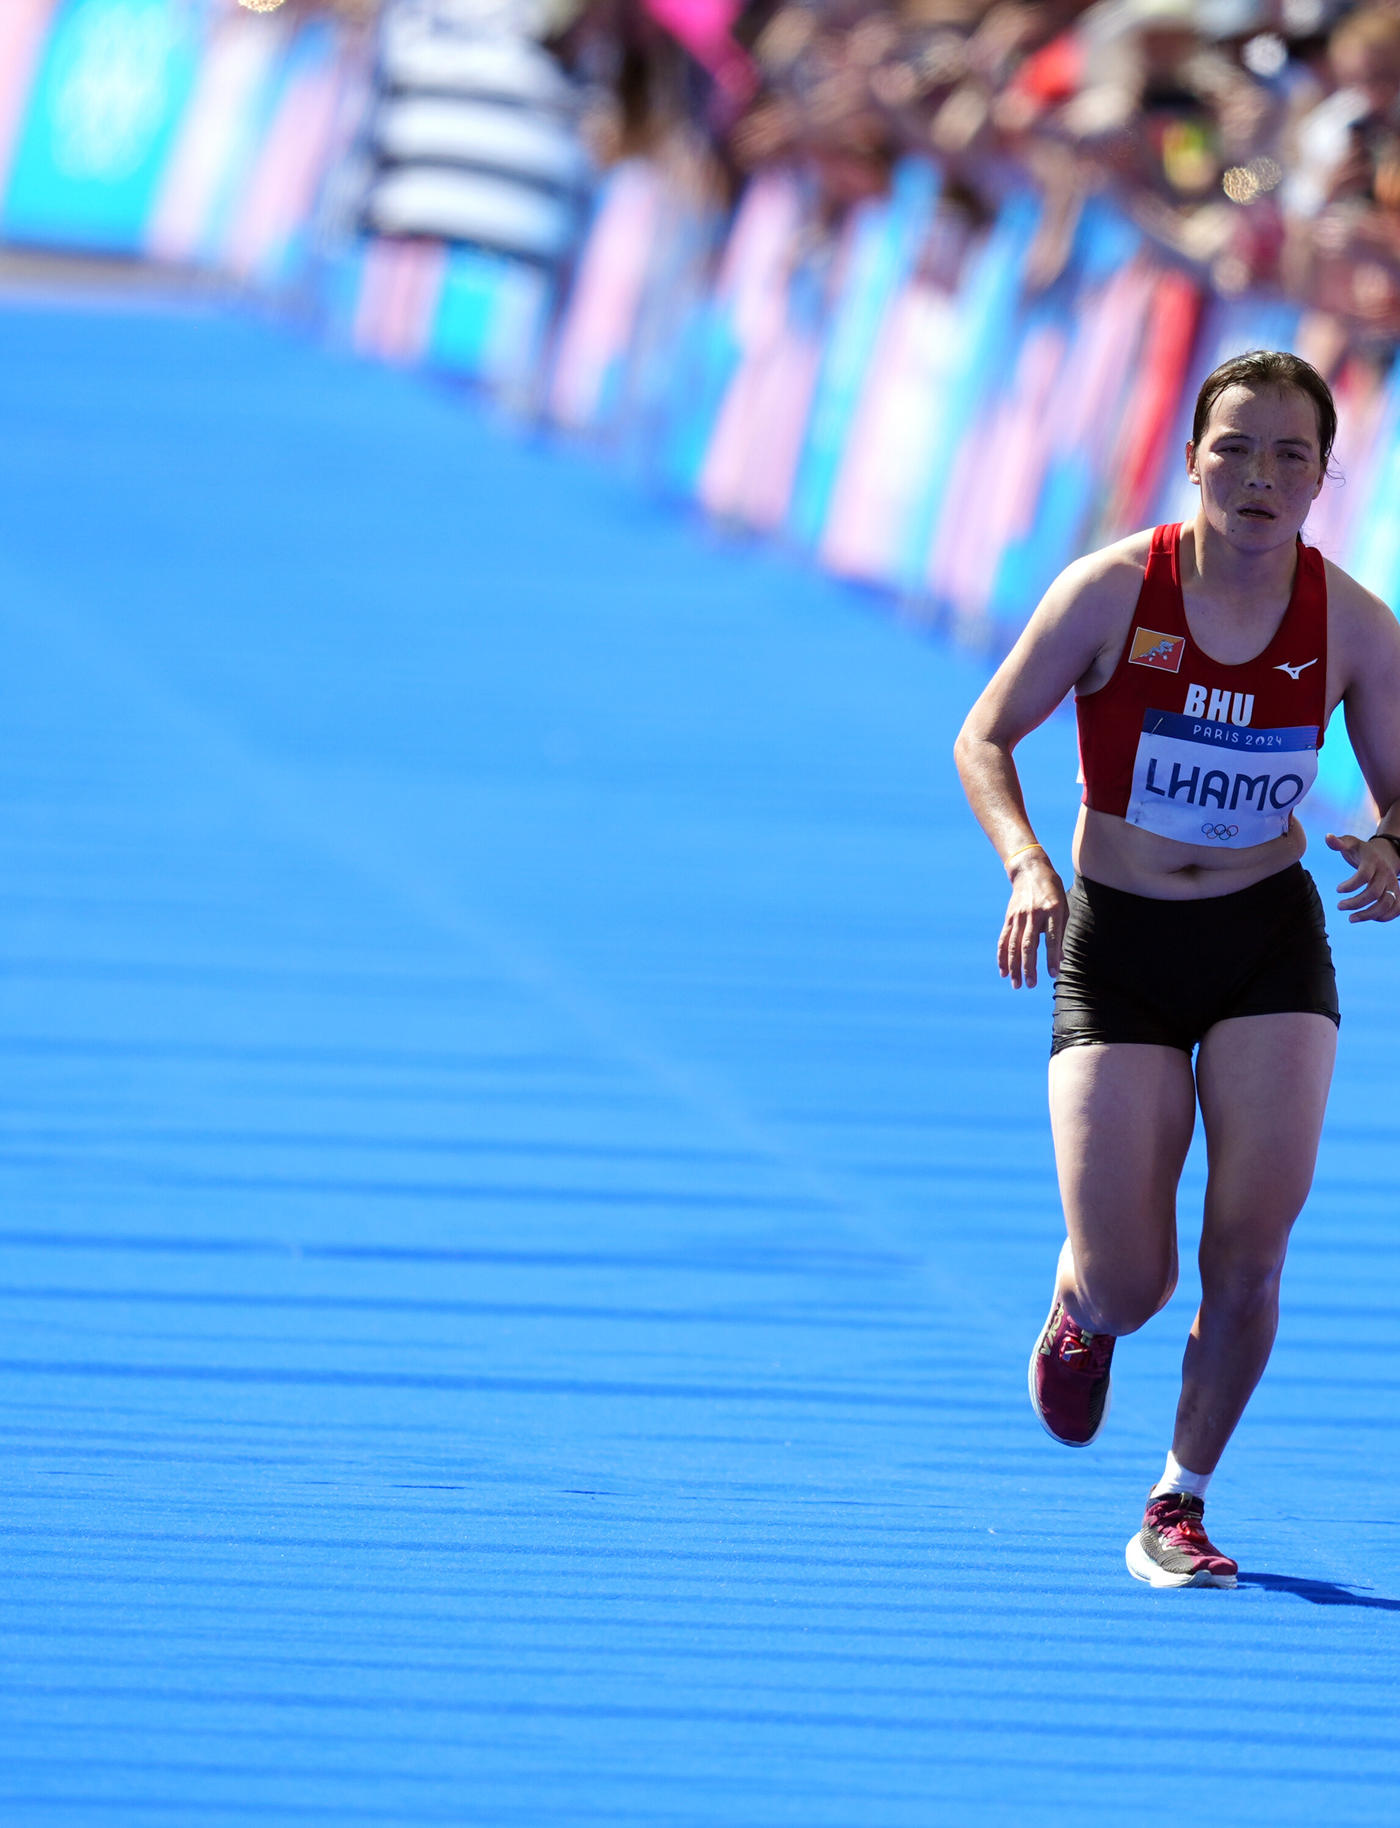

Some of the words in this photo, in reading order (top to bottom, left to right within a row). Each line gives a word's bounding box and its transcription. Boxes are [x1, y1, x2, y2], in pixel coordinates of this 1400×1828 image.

[1183, 683, 1255, 727] BHU
[1193, 725, 1239, 743] PARIS
[1245, 735, 1282, 746] 2024
[1145, 758, 1304, 811] LHAMO
